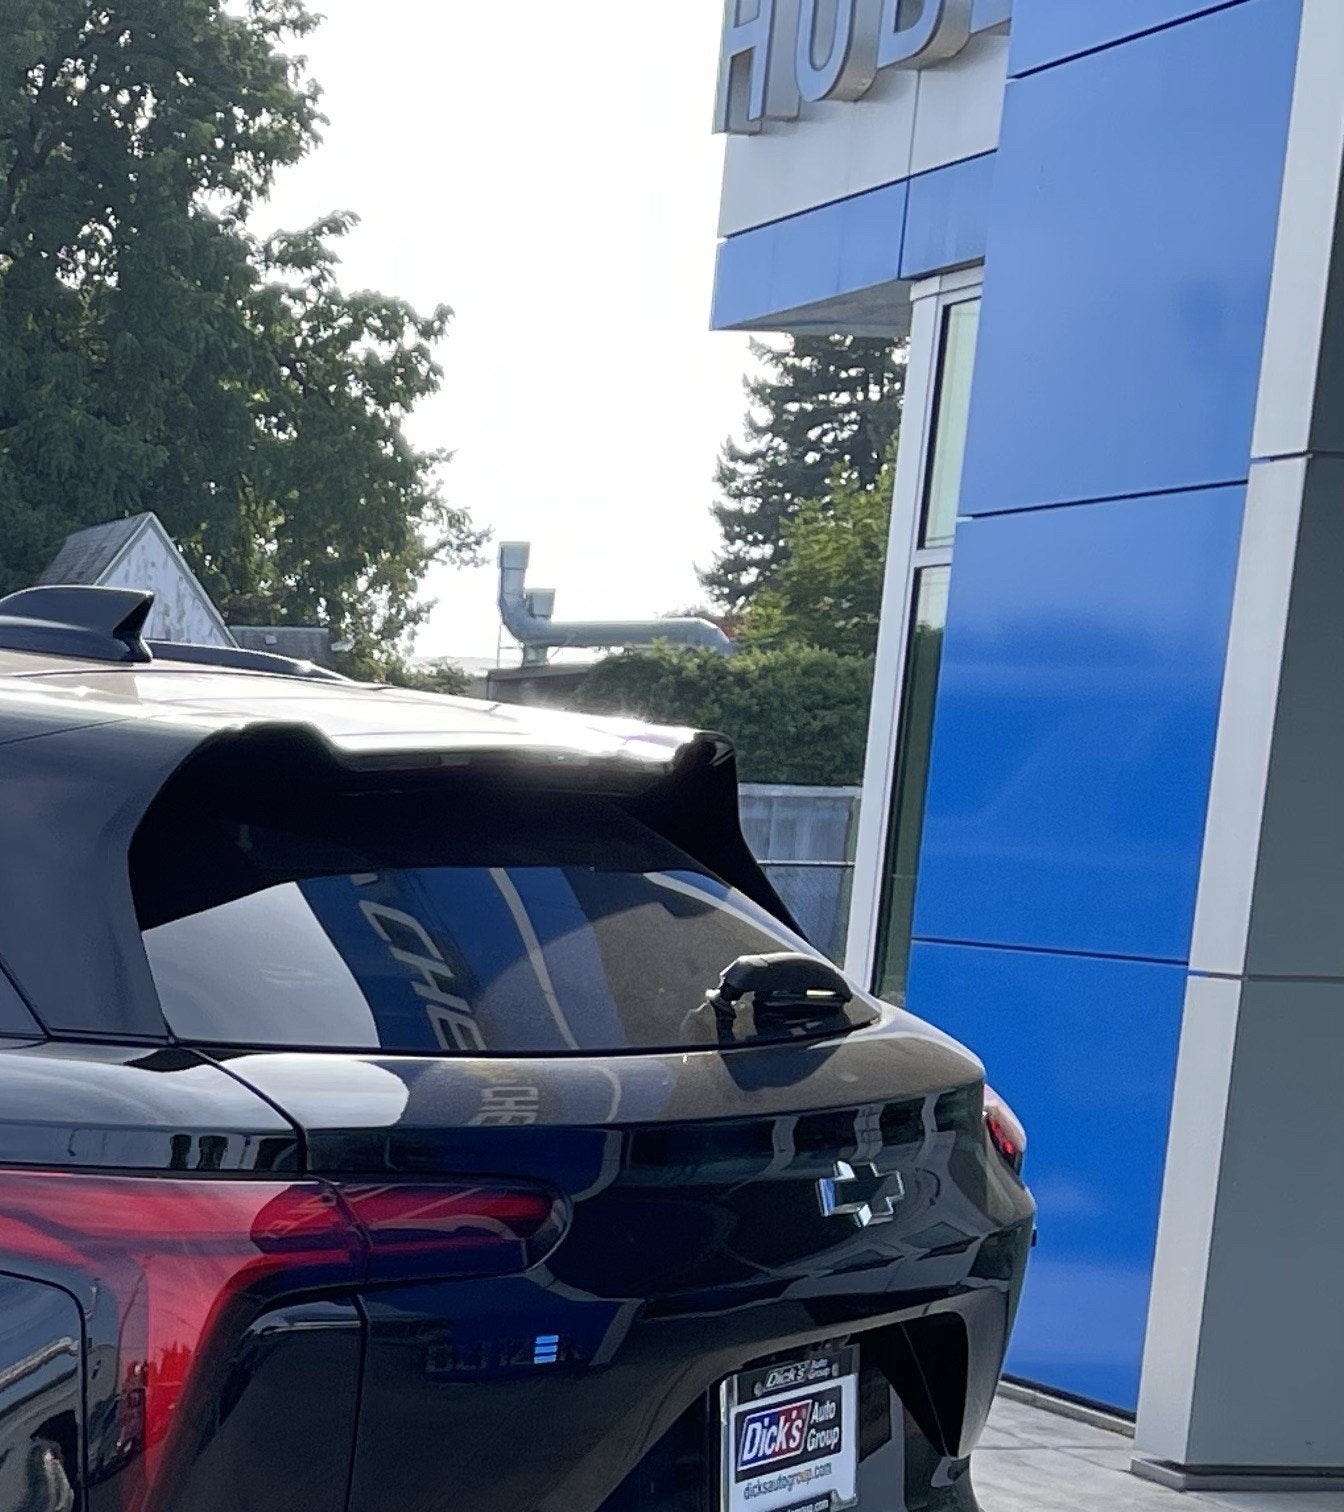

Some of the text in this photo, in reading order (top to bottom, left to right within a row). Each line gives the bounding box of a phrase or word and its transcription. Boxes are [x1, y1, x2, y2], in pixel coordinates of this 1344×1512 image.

[716, 0, 1012, 134] HU
[810, 1401, 837, 1424] Auto
[742, 1410, 804, 1461] Dick's
[806, 1426, 841, 1452] Group
[743, 1462, 832, 1500] dicksautogroup.com
